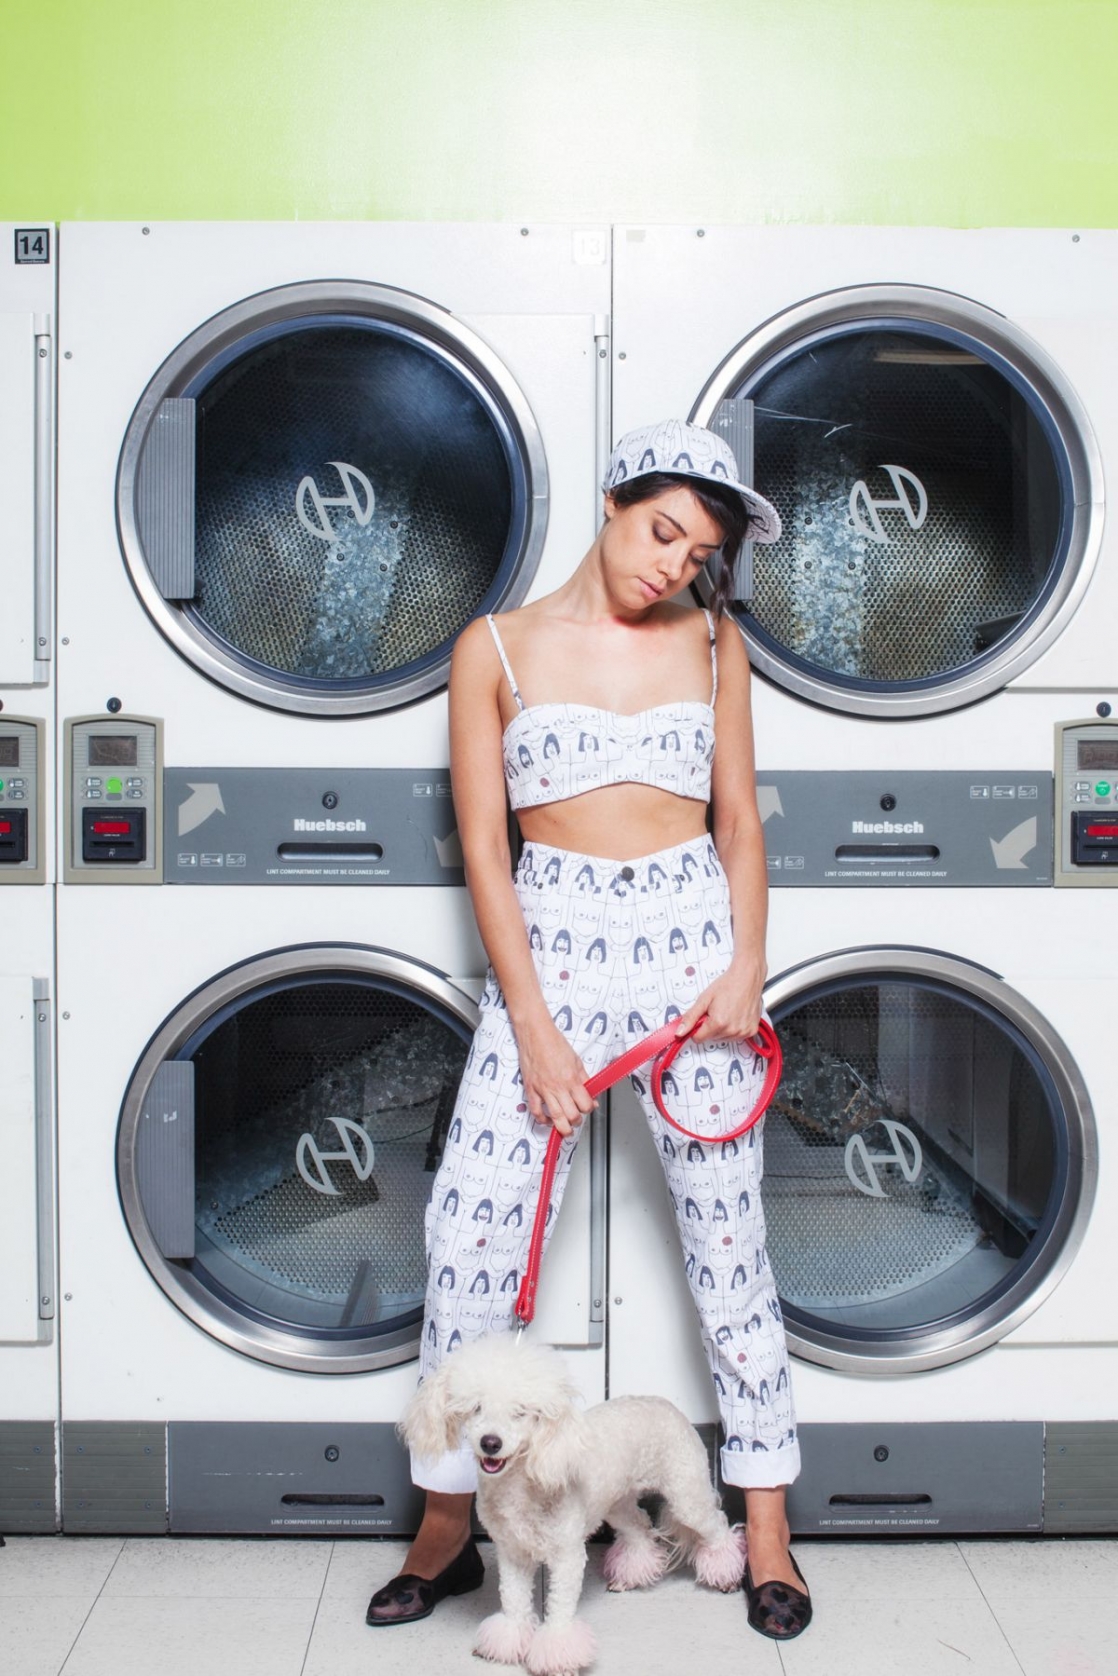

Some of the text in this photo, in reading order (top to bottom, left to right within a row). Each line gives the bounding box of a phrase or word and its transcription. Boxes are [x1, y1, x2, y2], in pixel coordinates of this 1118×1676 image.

[19, 236, 44, 255] 14
[581, 237, 600, 256] 13
[293, 818, 366, 832] Huebsch
[852, 820, 924, 834] Huebsch
